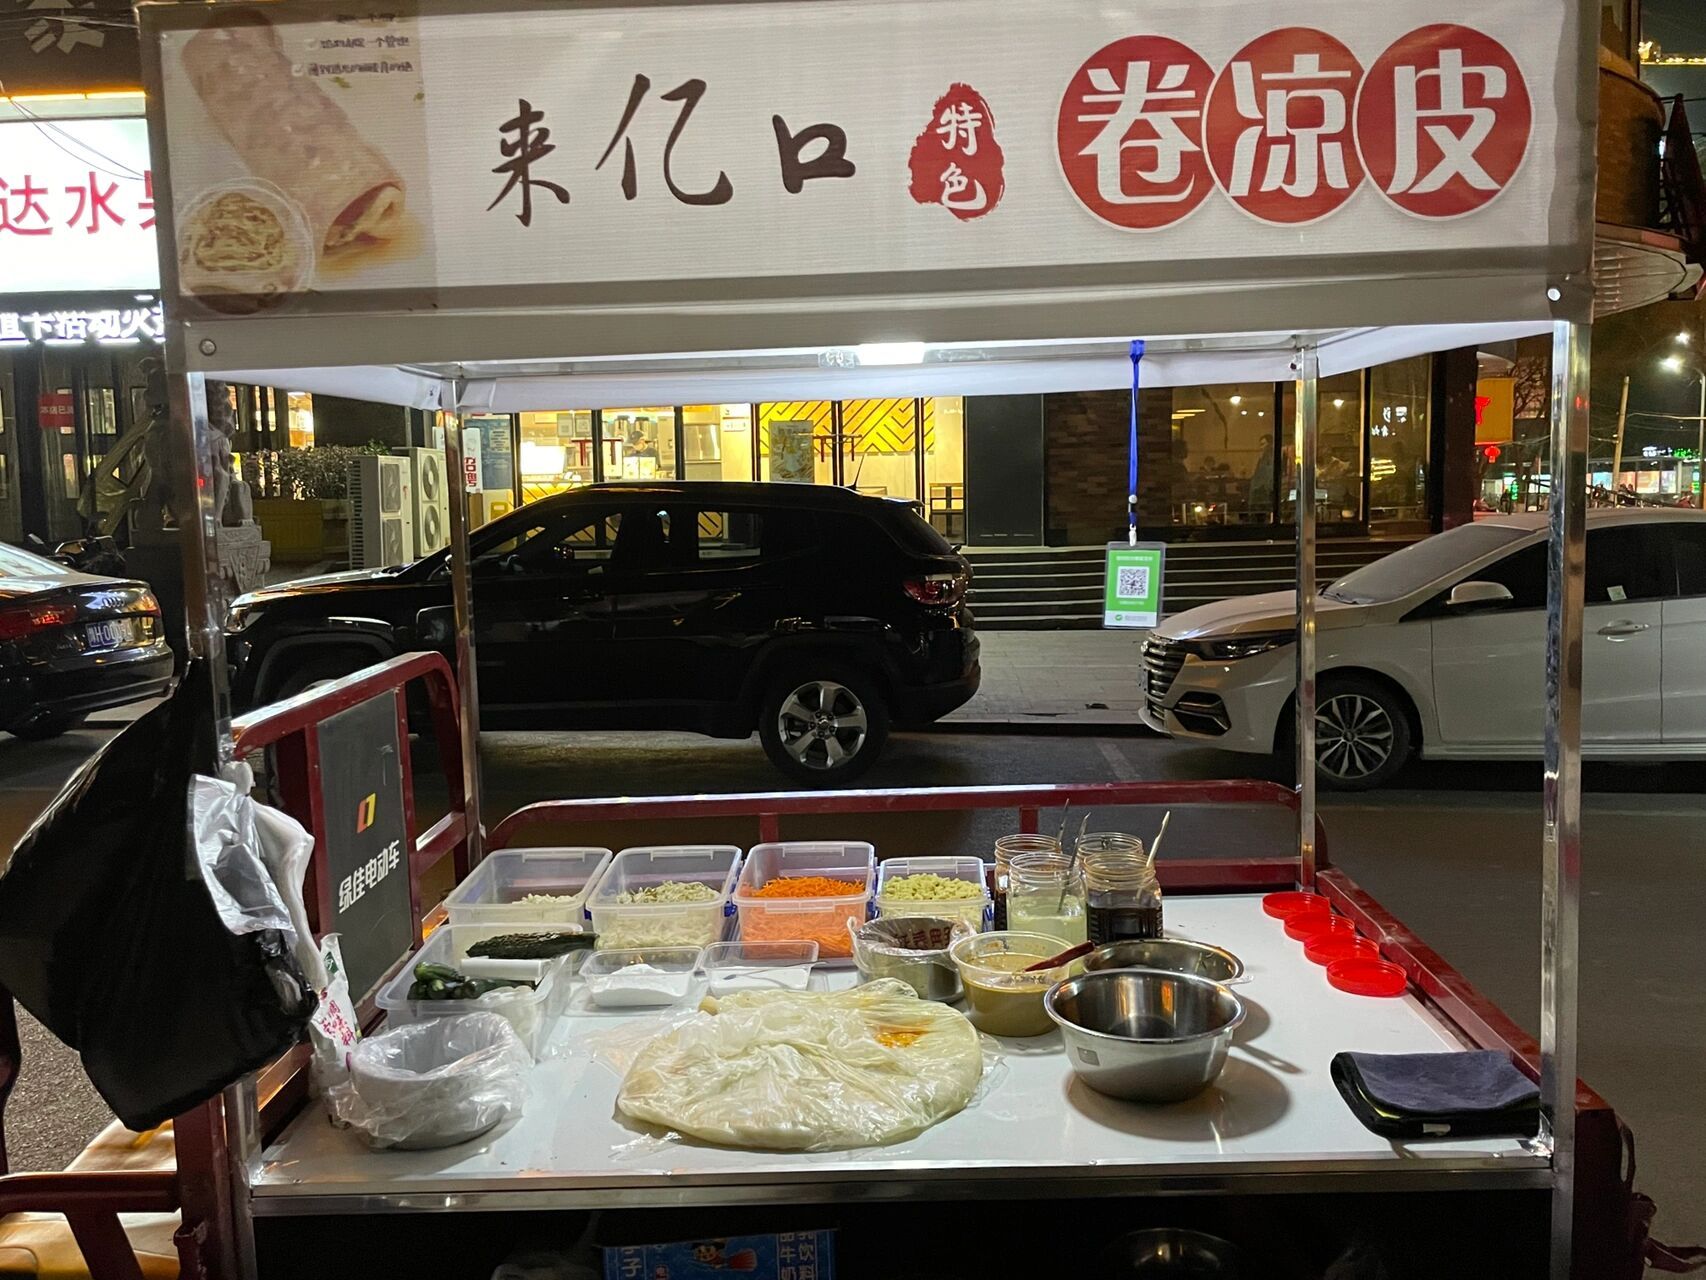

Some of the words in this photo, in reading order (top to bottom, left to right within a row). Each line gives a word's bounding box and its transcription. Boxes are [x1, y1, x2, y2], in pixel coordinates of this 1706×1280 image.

[487, 73, 856, 227] 来亿口
[936, 102, 985, 211] 特色
[1077, 49, 1506, 204] 卷凉皮
